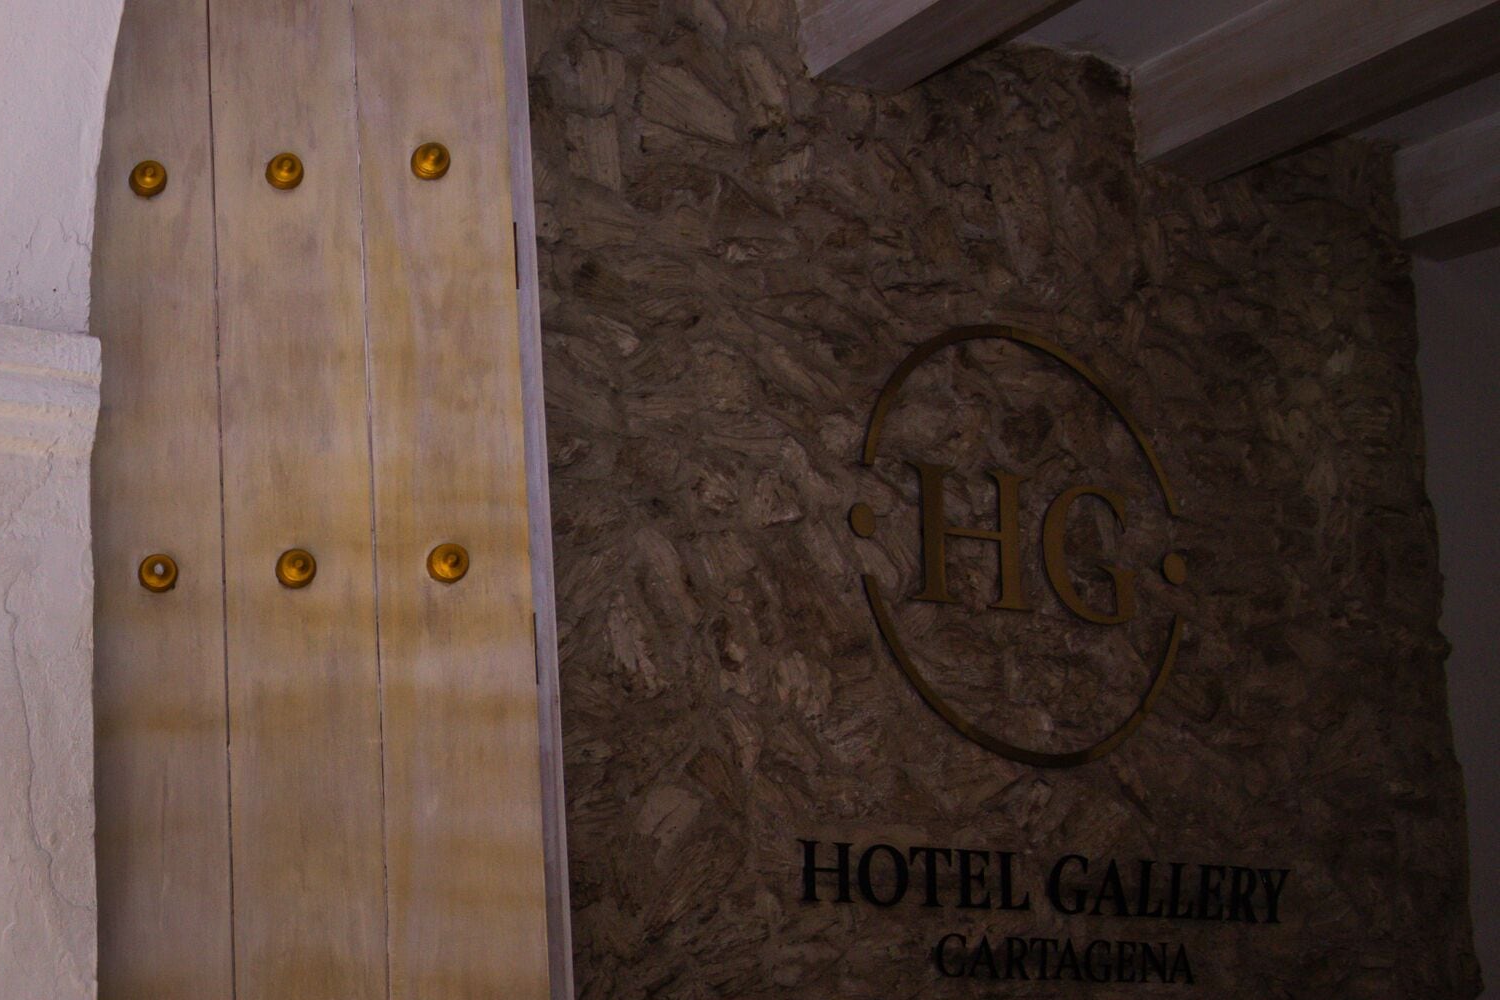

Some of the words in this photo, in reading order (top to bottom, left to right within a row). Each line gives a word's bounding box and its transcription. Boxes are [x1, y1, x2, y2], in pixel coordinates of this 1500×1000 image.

[904, 460, 1139, 626] HG
[796, 838, 1032, 913] HOTEL
[1047, 851, 1292, 926] GALLERY
[934, 932, 1196, 986] CARTAGENA
